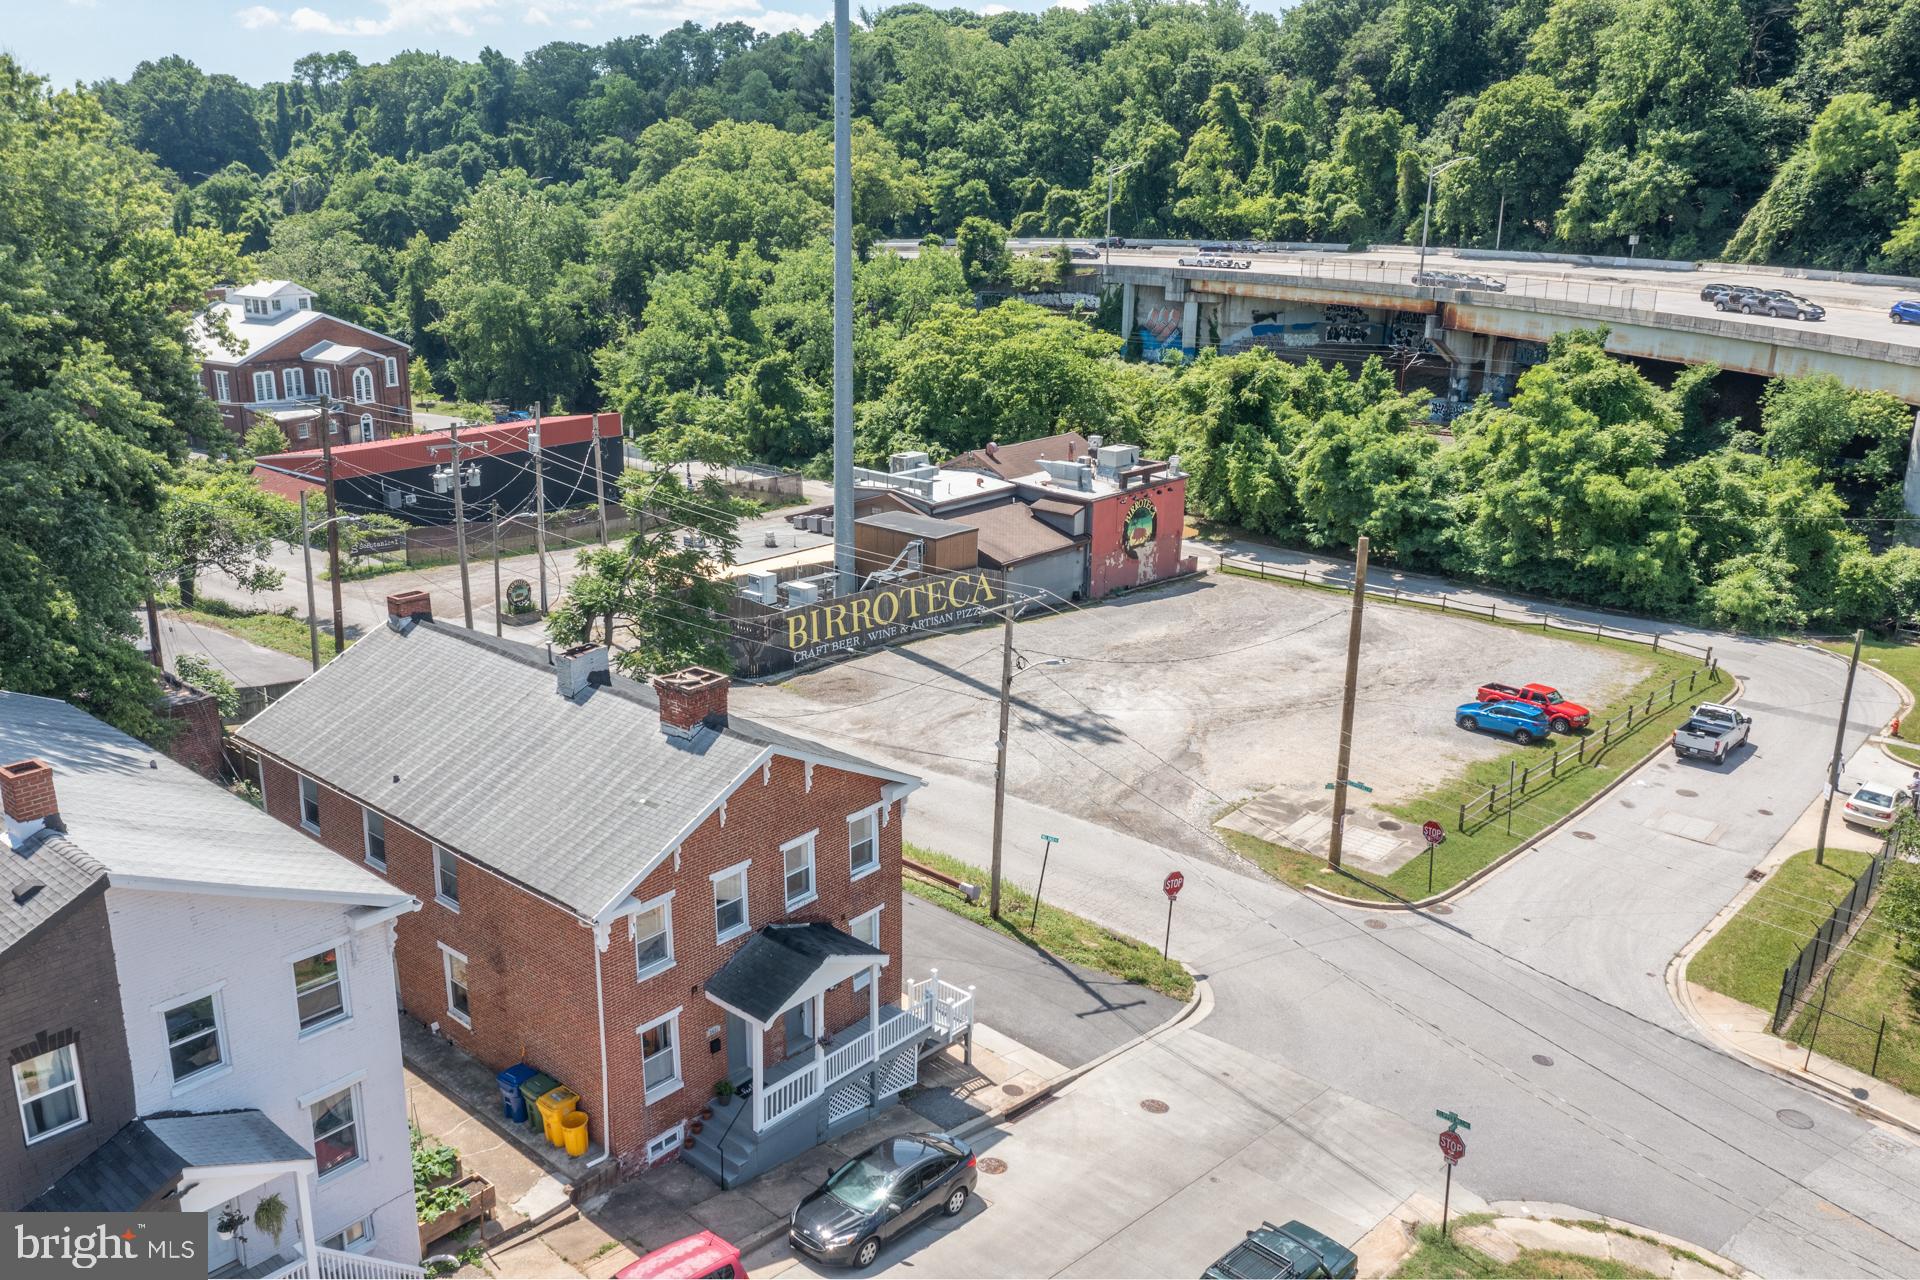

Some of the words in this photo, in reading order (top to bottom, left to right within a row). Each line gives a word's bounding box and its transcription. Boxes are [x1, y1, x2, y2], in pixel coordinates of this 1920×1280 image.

[787, 573, 996, 649] BIRROTECA
[794, 643, 829, 662] CRAFT
[868, 626, 897, 641] WINE
[900, 624, 909, 633] &
[911, 613, 953, 630] ARTISAN
[1424, 826, 1442, 837] STOP
[1166, 878, 1183, 889] STOP
[1440, 1136, 1463, 1151] STOP
